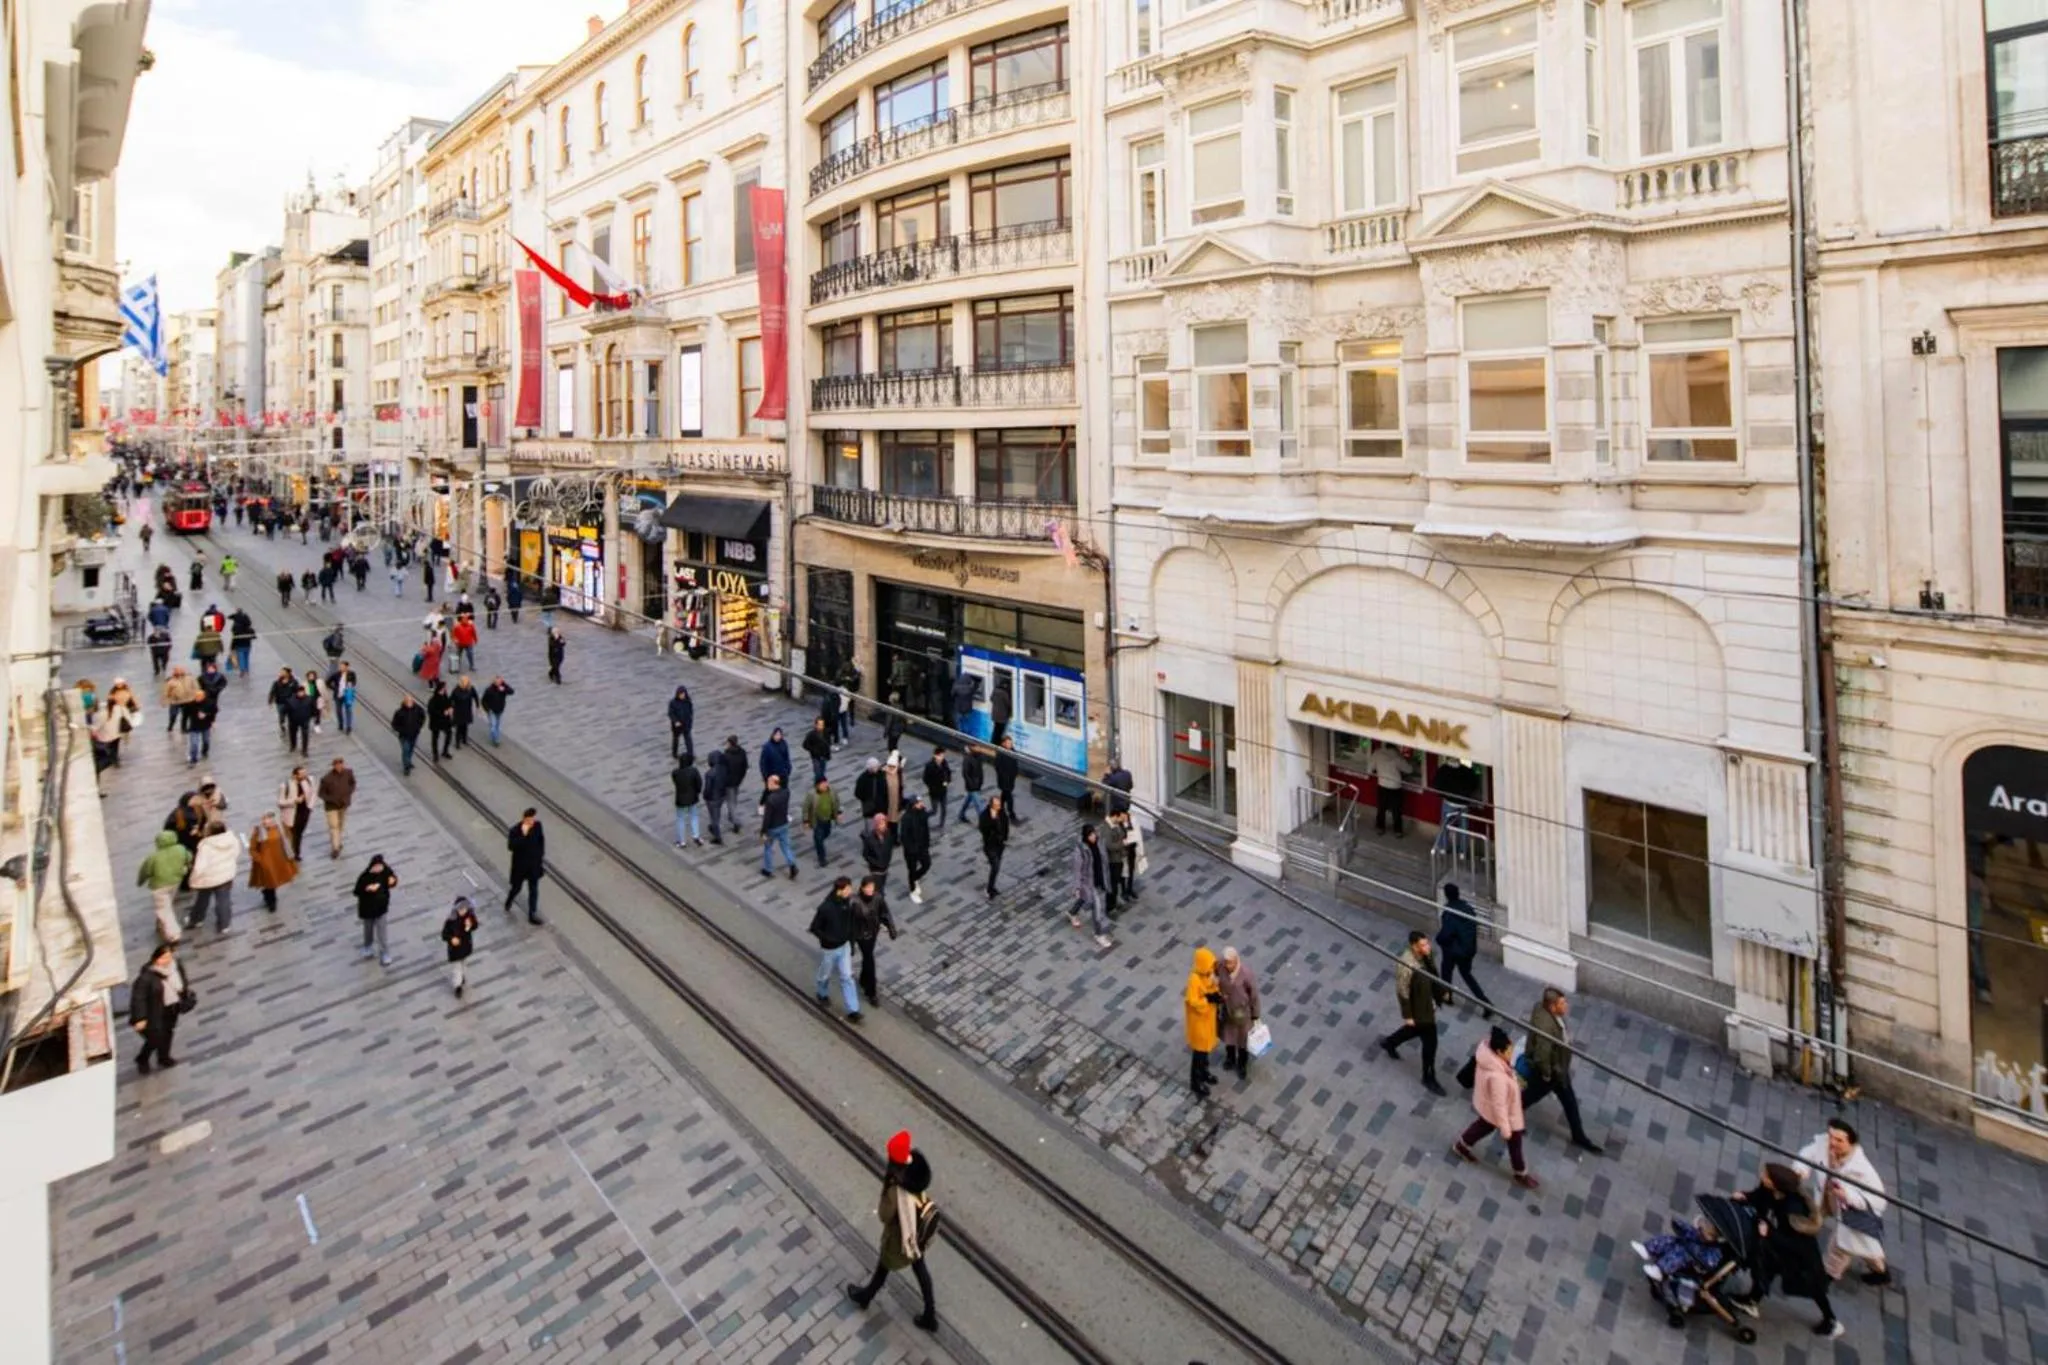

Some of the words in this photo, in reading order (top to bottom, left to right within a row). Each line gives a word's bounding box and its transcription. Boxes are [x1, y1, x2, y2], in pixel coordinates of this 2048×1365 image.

[666, 452, 704, 470] ATLAS
[724, 540, 756, 562] NBB
[708, 568, 749, 597] LOYA
[1300, 692, 1471, 750] AKBANK
[1989, 784, 2048, 817] Ara
